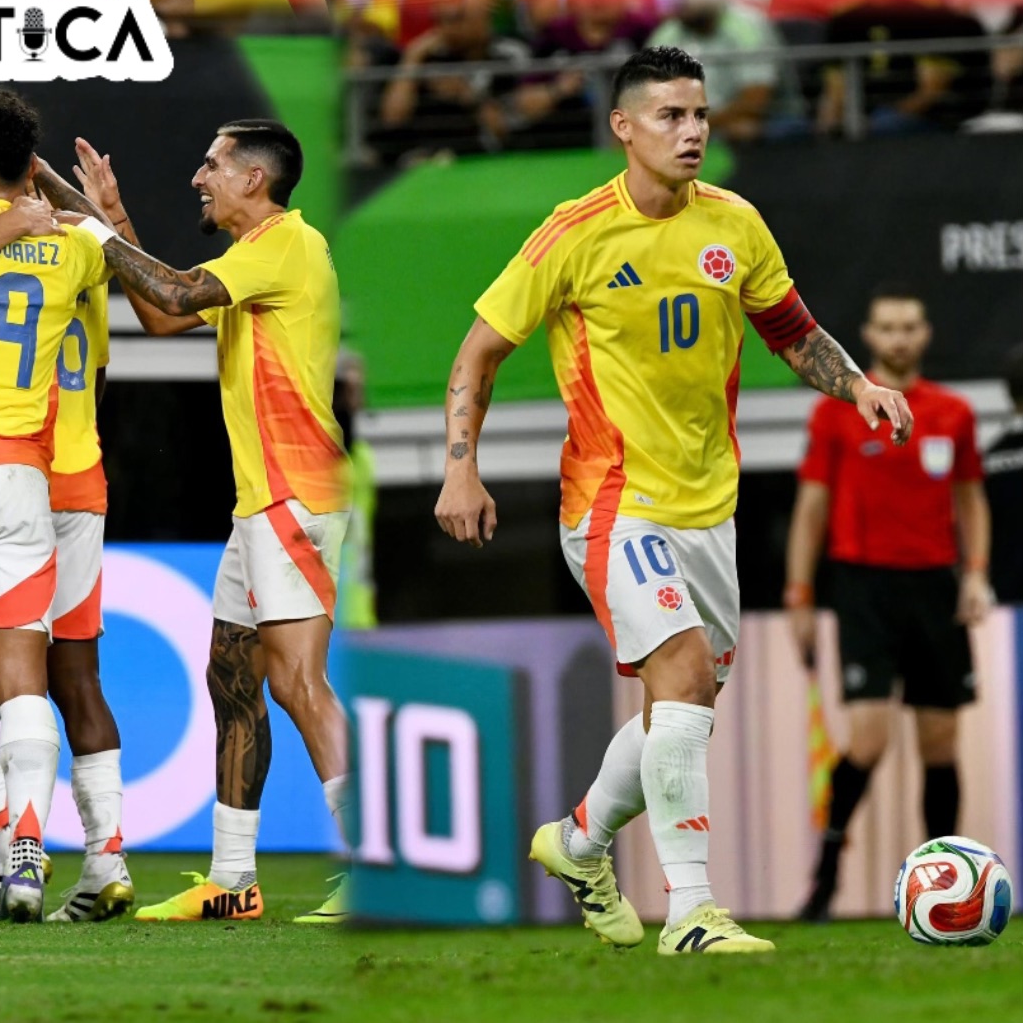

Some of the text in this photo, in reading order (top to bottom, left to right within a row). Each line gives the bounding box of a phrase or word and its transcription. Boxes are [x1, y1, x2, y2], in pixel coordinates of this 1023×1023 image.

[659, 293, 699, 353] 10
[623, 534, 676, 585] 10
[202, 884, 258, 921] NIKE
